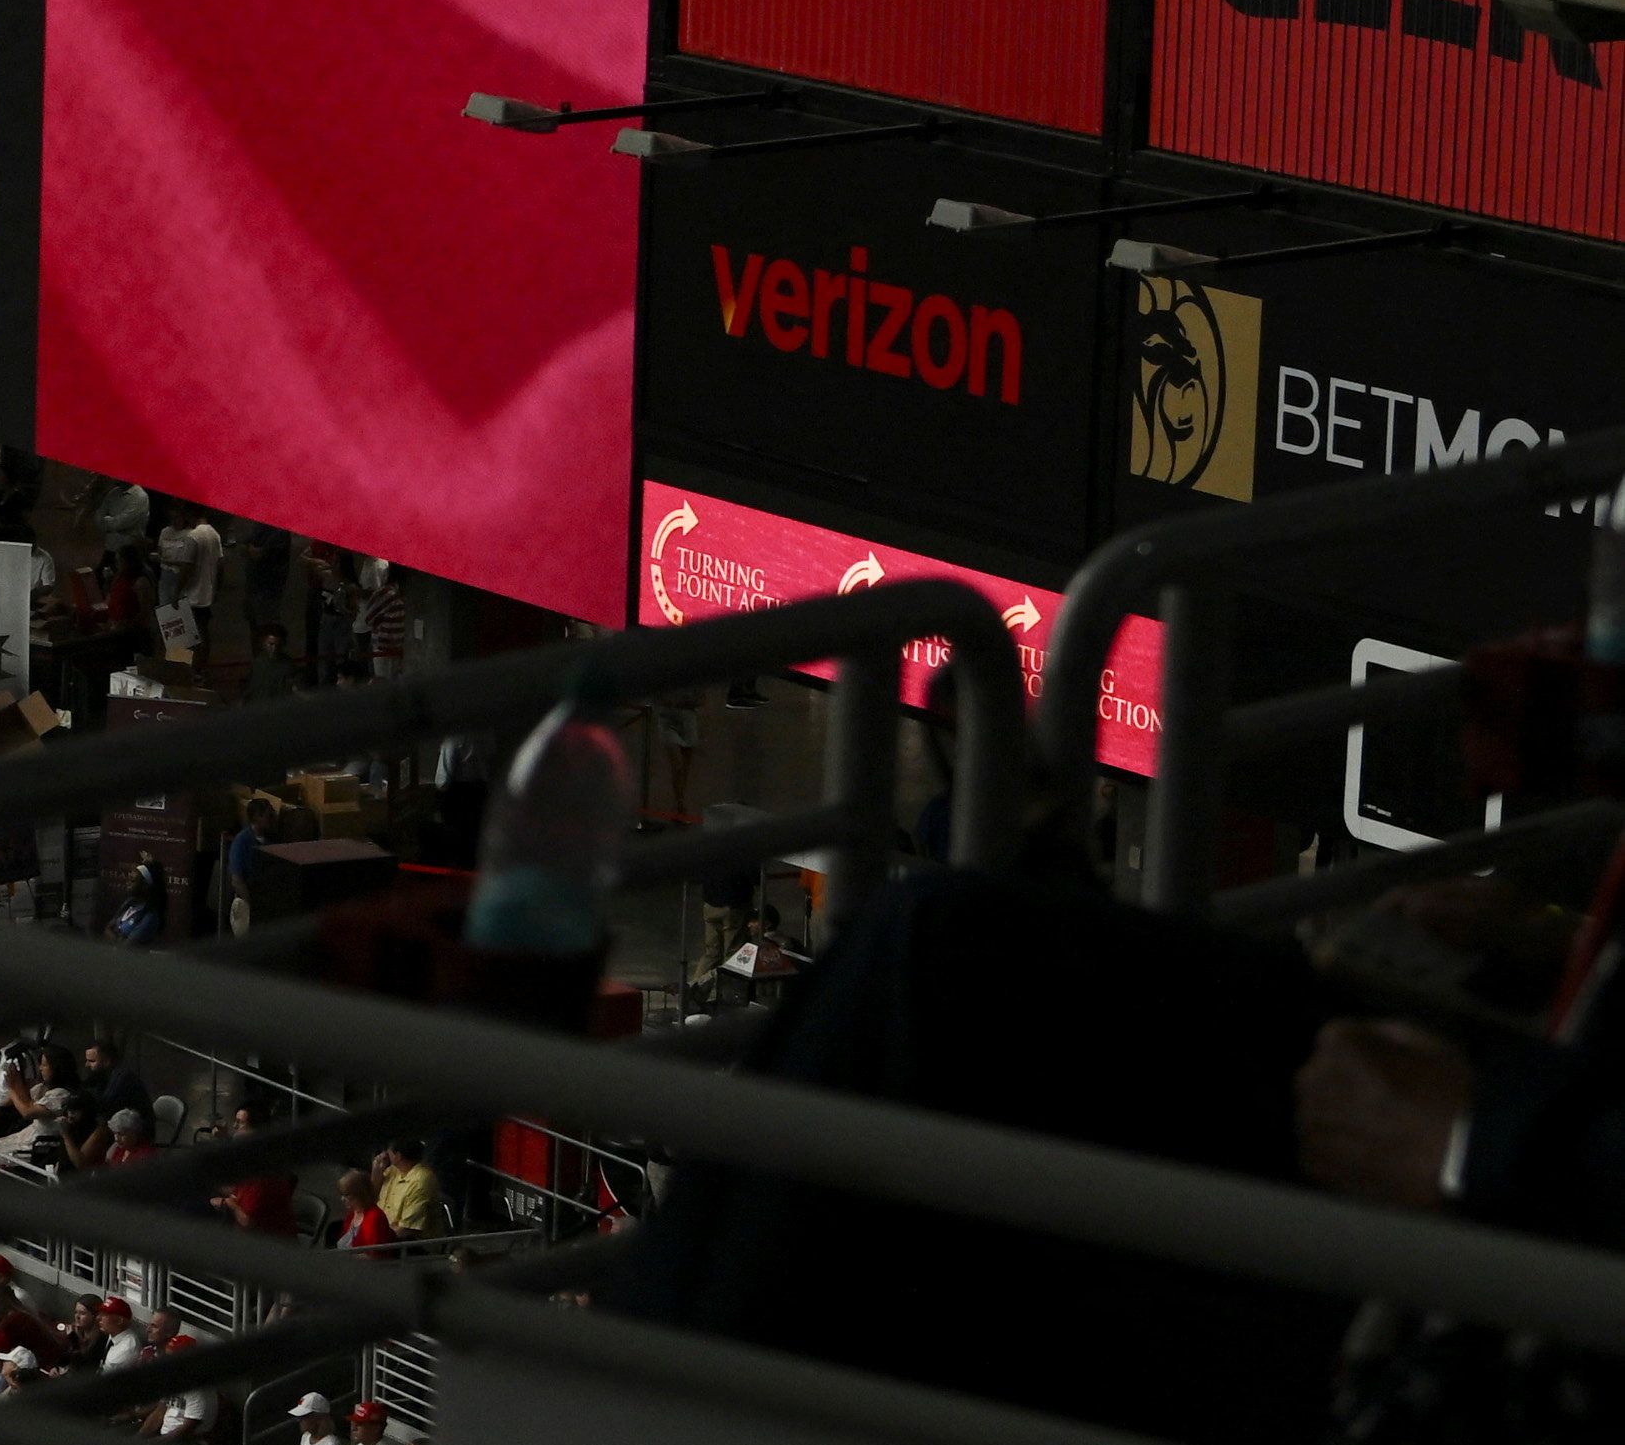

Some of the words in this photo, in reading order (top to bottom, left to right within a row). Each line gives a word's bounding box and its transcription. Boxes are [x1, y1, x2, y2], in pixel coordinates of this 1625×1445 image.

[710, 242, 1024, 406] verizon
[676, 546, 766, 592] TURNING
[676, 575, 732, 610] POINT
